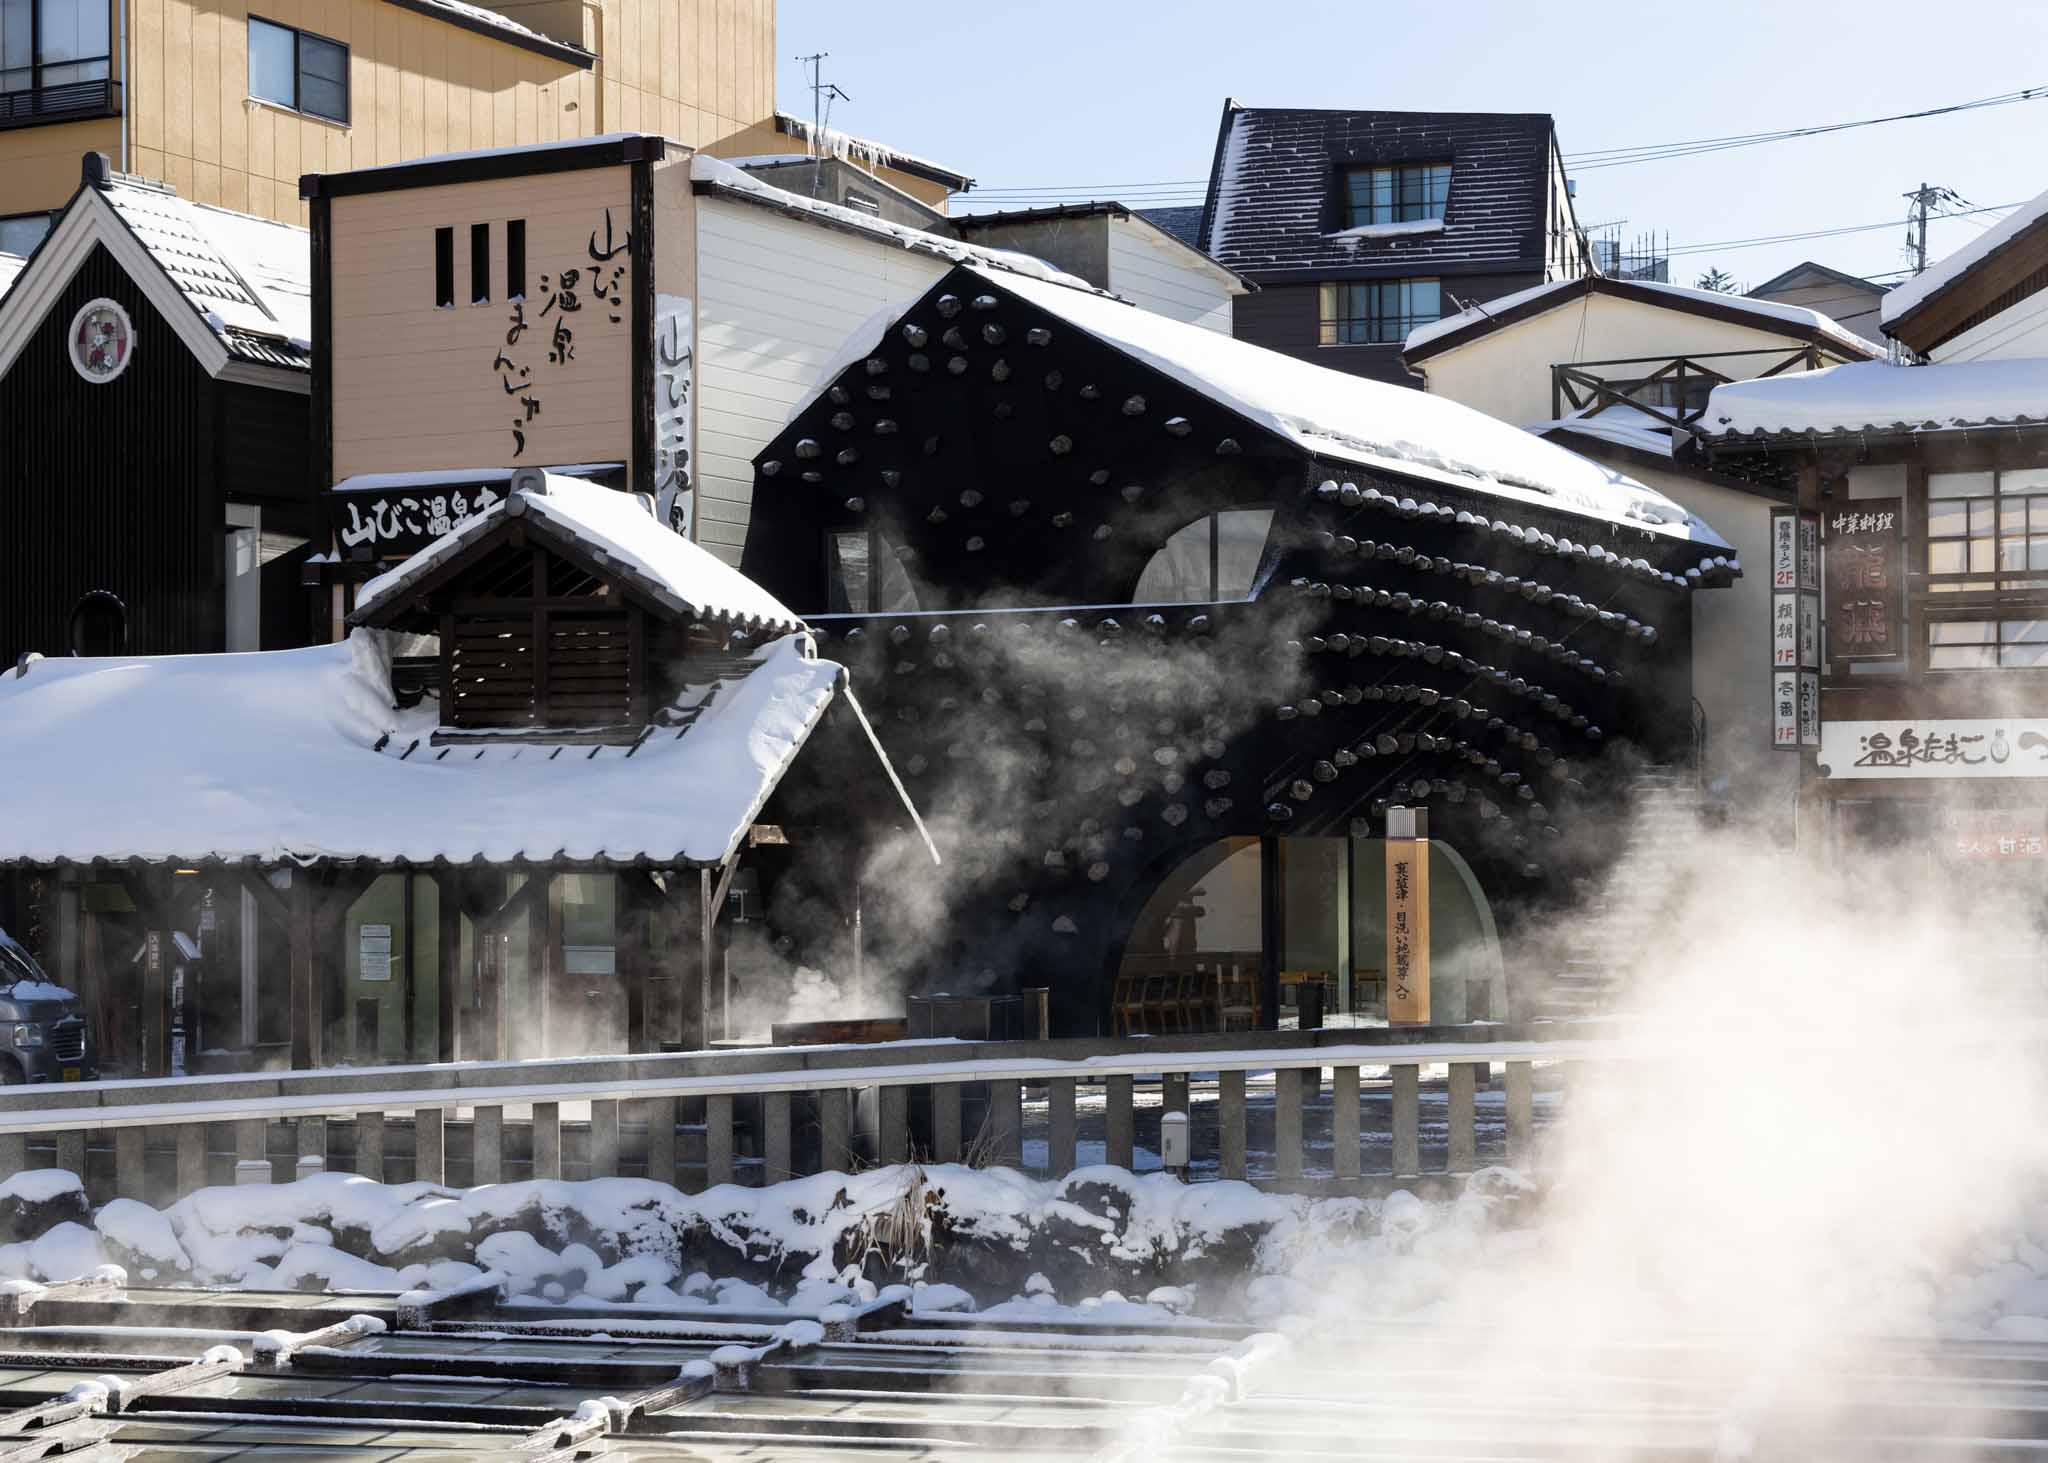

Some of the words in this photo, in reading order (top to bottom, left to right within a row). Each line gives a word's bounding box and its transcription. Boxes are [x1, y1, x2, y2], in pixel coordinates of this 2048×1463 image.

[586, 208, 632, 324] 山びこ
[539, 269, 582, 366] 温泉
[1832, 512, 1895, 536] 中華料理
[1777, 571, 1793, 585] 2F
[1776, 603, 1793, 639] 頼朝
[1776, 649, 1794, 662] 1F
[1778, 681, 1793, 717] 壱番
[1777, 728, 1794, 740] 1F
[1853, 728, 1987, 768] 温泉たまご
[1394, 984, 1410, 1000] 入口
